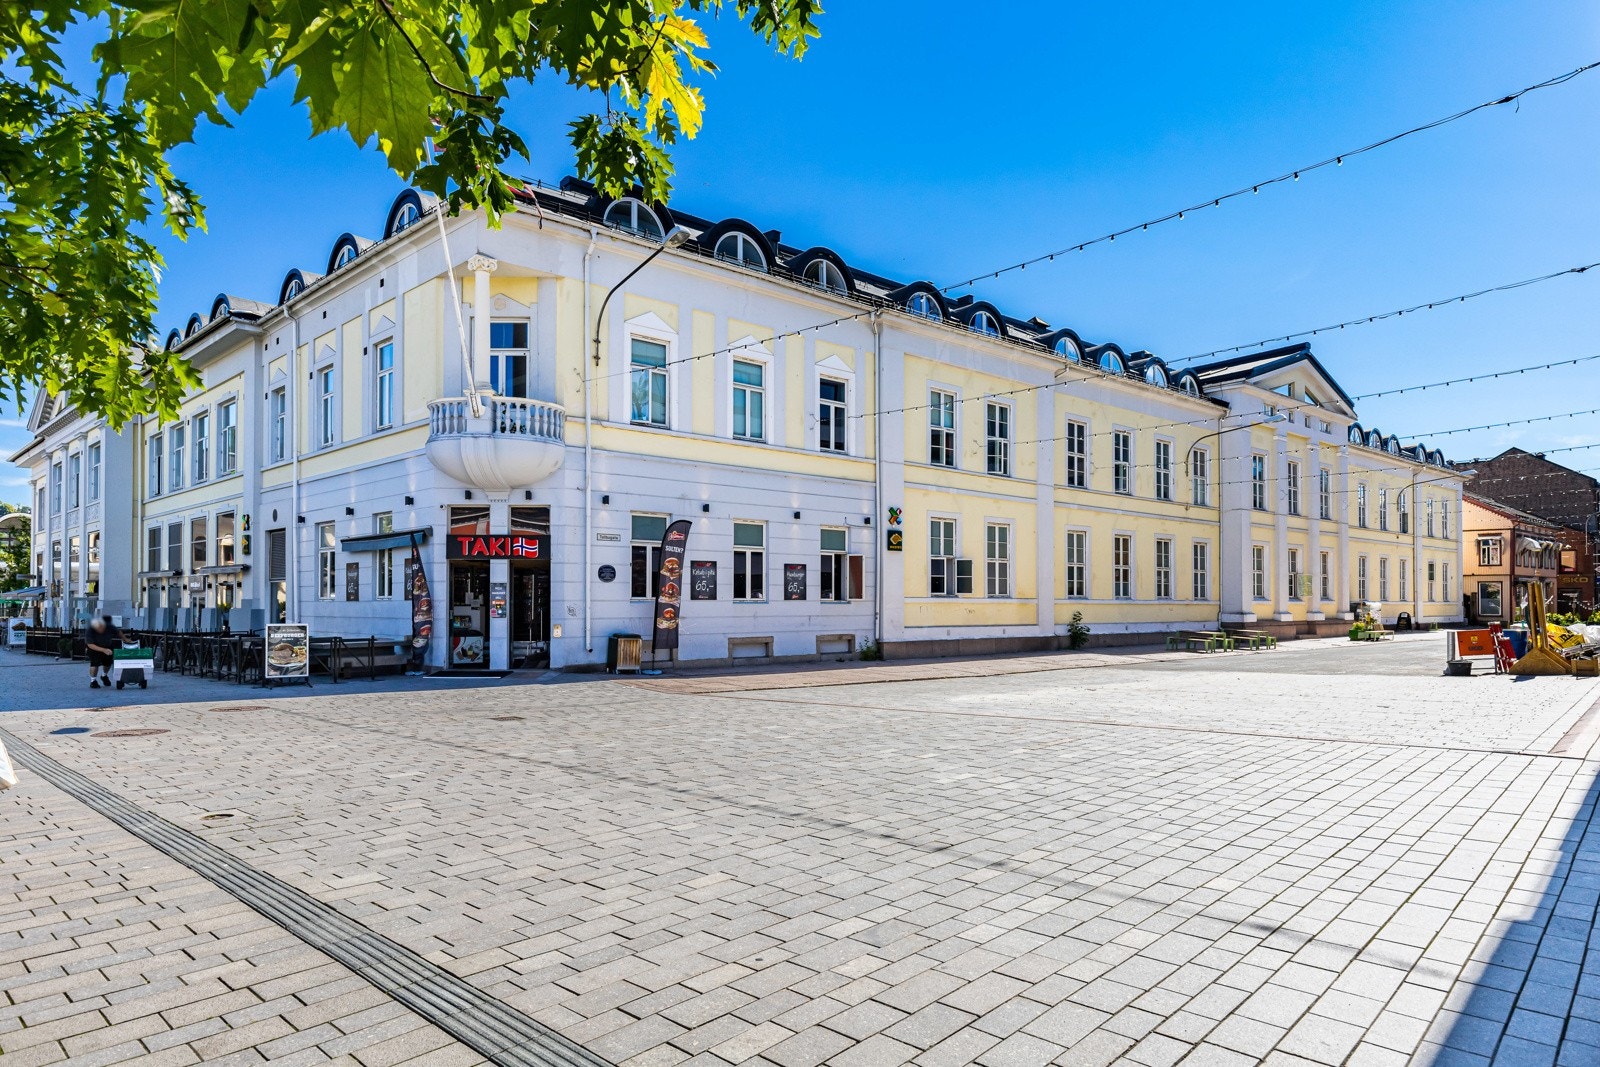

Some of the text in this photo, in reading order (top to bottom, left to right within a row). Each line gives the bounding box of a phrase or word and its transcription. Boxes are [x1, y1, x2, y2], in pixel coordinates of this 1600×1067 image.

[457, 537, 511, 556] TAKI
[665, 545, 684, 554] SULTEN?
[1562, 576, 1589, 584] SKO
[695, 580, 714, 592] 65,-
[788, 582, 804, 593] 65,-
